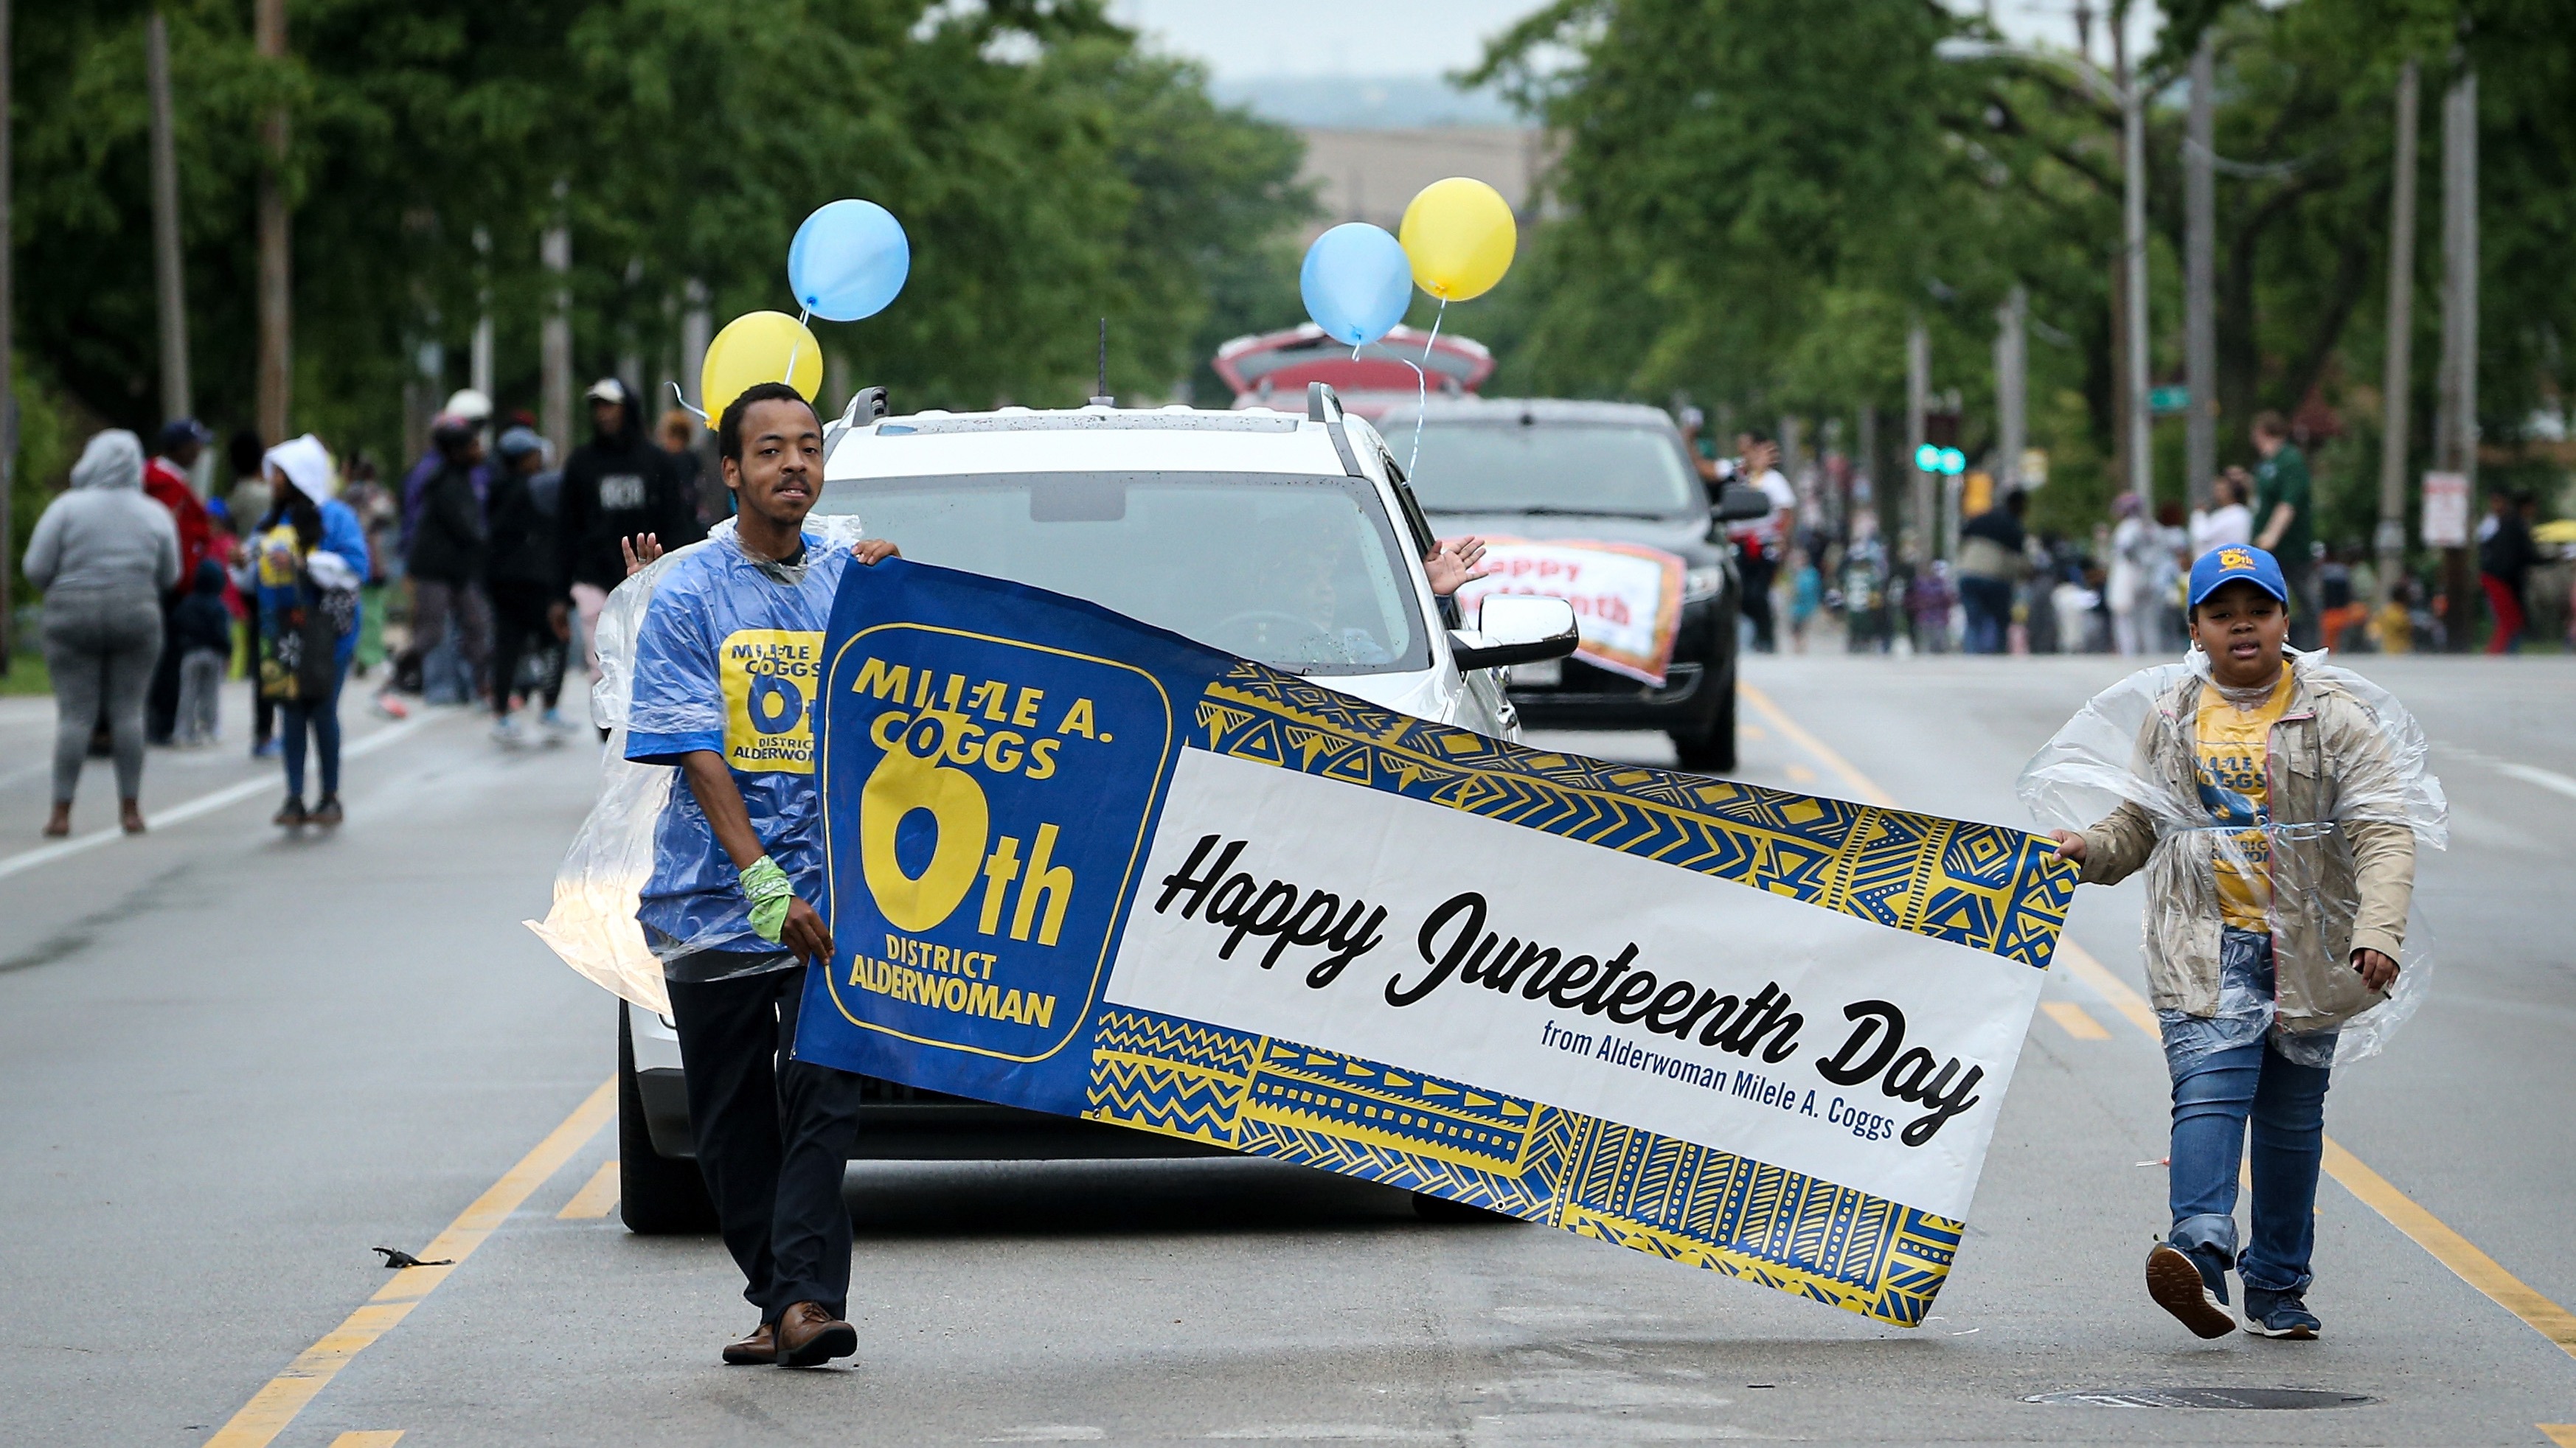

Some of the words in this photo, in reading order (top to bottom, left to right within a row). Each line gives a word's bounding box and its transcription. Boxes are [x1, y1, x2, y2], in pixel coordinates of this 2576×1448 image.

[745, 659, 821, 678] COGGS
[851, 656, 1044, 728] MILELE
[1057, 697, 1114, 743] A.
[869, 710, 1061, 780] COGGS
[860, 700, 1075, 947] 6th
[848, 954, 1057, 1029] ALDERWOMAN
[885, 933, 996, 981] DISTRICT
[1153, 834, 1389, 989] Happy
[1384, 891, 1805, 1064] Juneteenth
[1814, 1000, 1985, 1148] Day
[1541, 1020, 1591, 1057] from
[1596, 1033, 1727, 1093] Alderwoman
[1732, 1070, 1796, 1112] Milele
[1799, 1090, 1820, 1119] A.
[1827, 1096, 1895, 1141] Coggs
